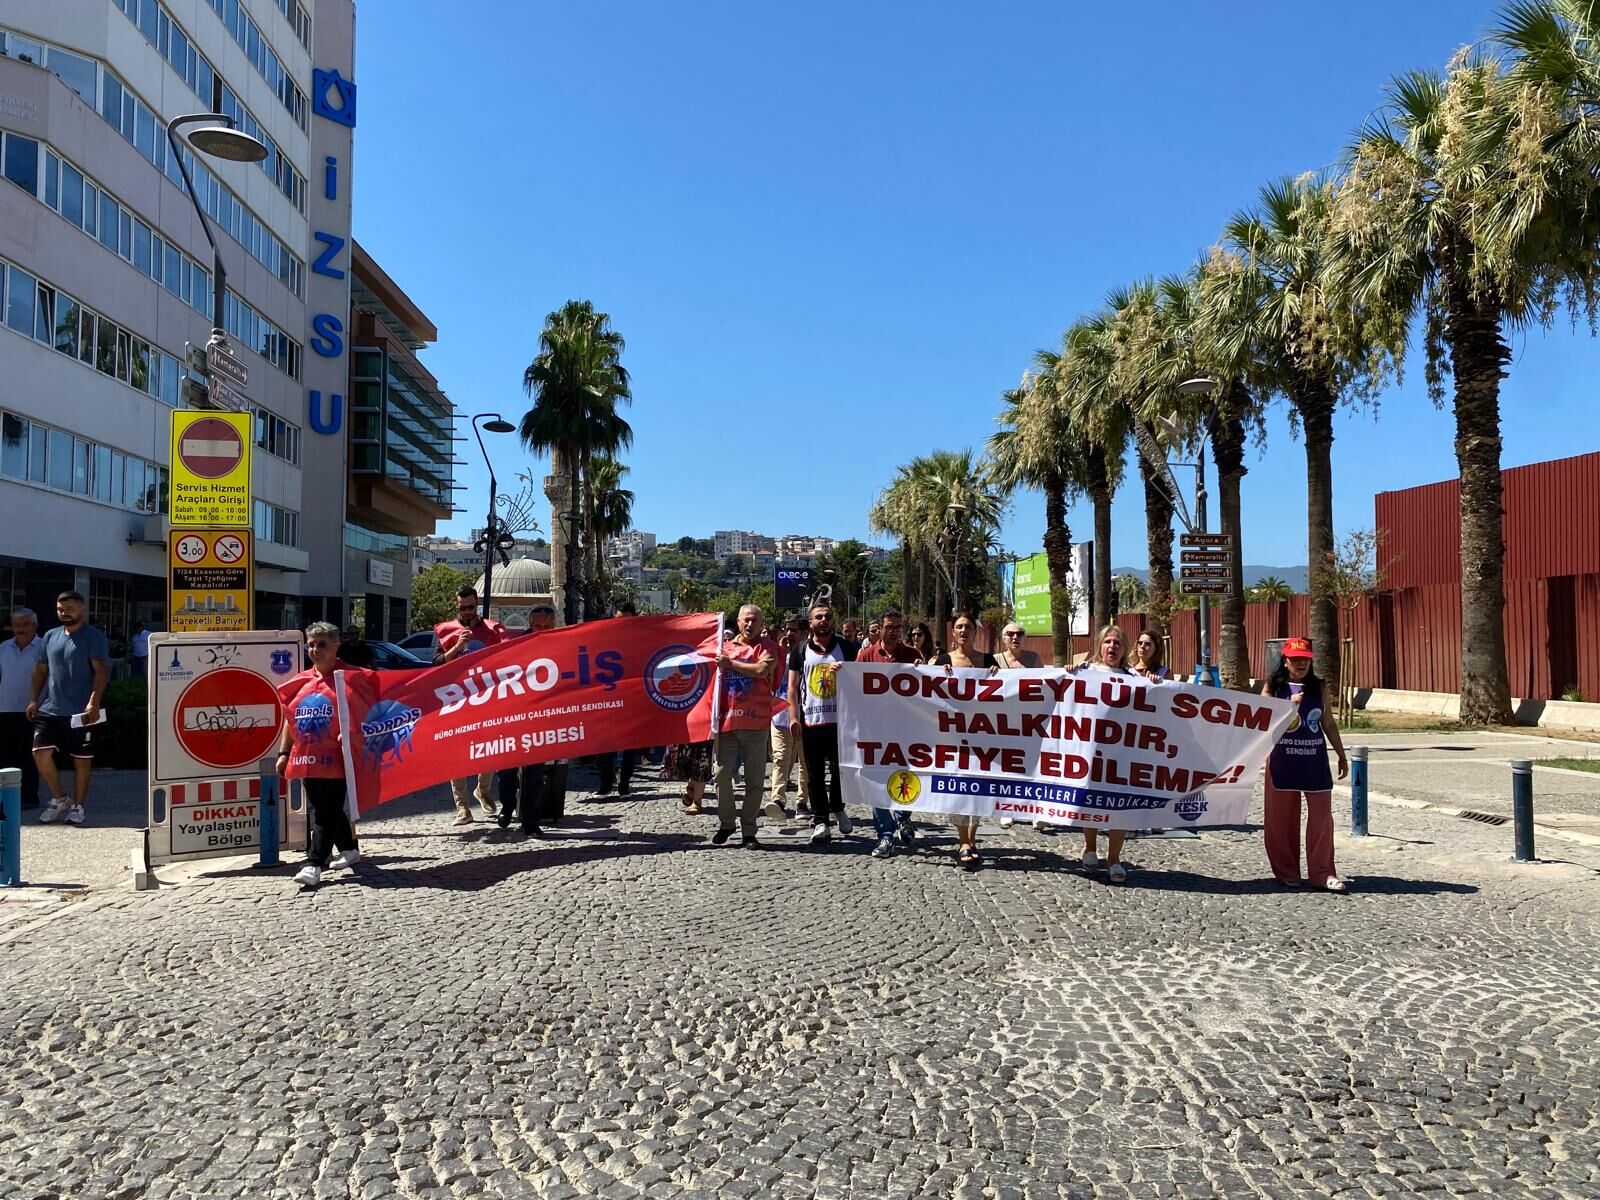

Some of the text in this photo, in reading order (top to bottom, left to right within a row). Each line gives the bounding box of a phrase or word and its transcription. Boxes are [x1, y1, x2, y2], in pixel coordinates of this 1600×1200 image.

[308, 155, 345, 436] İZSU
[176, 483, 246, 493] Servis Hizmet
[176, 494, 246, 505] Araçları Girişi
[204, 575, 238, 583] Trafiğine
[778, 571, 809, 579] CNBC-e
[434, 646, 625, 716] BÜRO-İŞ
[863, 672, 1273, 731] DOKUZ EYLÜL SGM
[434, 730, 454, 741] BÜRO
[455, 722, 481, 735] HİZMET
[482, 718, 503, 728] KOLU
[504, 713, 527, 724] KAMU
[528, 705, 580, 720] ÇALIŞANLARI
[938, 711, 1179, 758] HALKINDIR,
[469, 721, 585, 760] İZMİR ŞUBESİ
[857, 739, 1026, 774] TASFİYE
[937, 776, 980, 793] BÜRO
[989, 783, 1077, 803] EMEKÇİLERİ
[193, 805, 257, 822] DİKKAT
[995, 801, 1110, 823] İZMİR ŞUBESİ
[1173, 801, 1209, 813] KESK
[208, 834, 252, 847] Bölge
